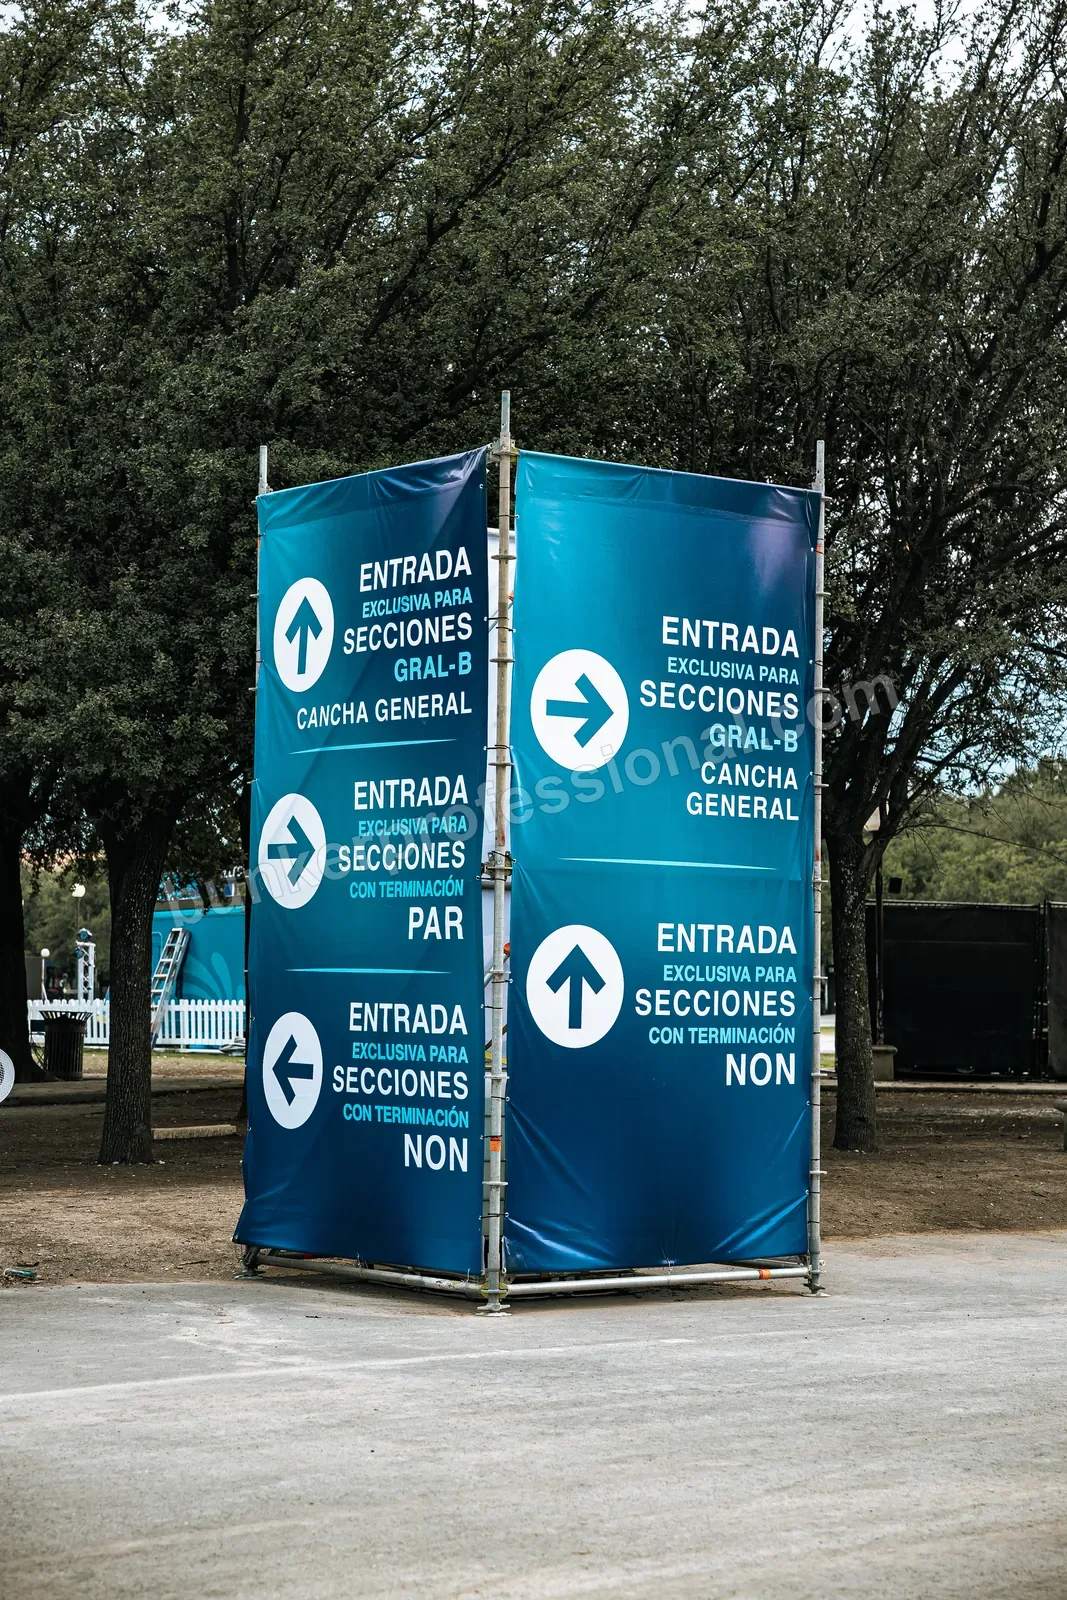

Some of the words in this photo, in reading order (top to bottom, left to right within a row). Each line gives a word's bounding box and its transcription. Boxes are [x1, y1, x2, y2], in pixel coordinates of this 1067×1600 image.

[360, 547, 472, 592] ENTRADA
[362, 593, 431, 619] EXCLUSIVA
[434, 587, 473, 607] PARA
[343, 612, 473, 655] SECCIONES
[662, 615, 800, 658] ENTRADA
[394, 651, 472, 683] GRAL-B
[667, 657, 755, 681] EXCLUSIVA
[759, 666, 799, 685] PARA
[297, 701, 369, 730] CANCHA
[374, 691, 472, 722] GENERAL
[639, 680, 799, 720] SECCIONES
[709, 723, 798, 753] GRAL-B
[701, 761, 799, 790] CANCHA
[354, 774, 469, 810] ENTRADA
[686, 792, 799, 821] GENERAL
[358, 817, 428, 837] EXCLUSIVA
[432, 815, 467, 833] PARA
[338, 840, 466, 872] SECCIONES
[350, 881, 376, 898] CON
[379, 875, 464, 898] TERMINACIÓN
[408, 906, 464, 940] PAR
[657, 922, 797, 955] ENTRADA
[663, 964, 751, 982] EXCLUSIVA
[755, 966, 797, 983] PARA
[349, 1002, 468, 1035] ENTRADA
[634, 988, 796, 1017] SECCIONES
[648, 1026, 683, 1045] CON
[688, 1022, 796, 1044] TERMINACIÓN
[352, 1042, 426, 1062] EXCLUSIVA
[430, 1045, 469, 1064] PARA
[725, 1052, 796, 1086] NON
[332, 1065, 469, 1100] SECCIONES
[343, 1103, 371, 1122] CON
[375, 1105, 469, 1128] TERMINACIÓN
[404, 1133, 468, 1173] NON
